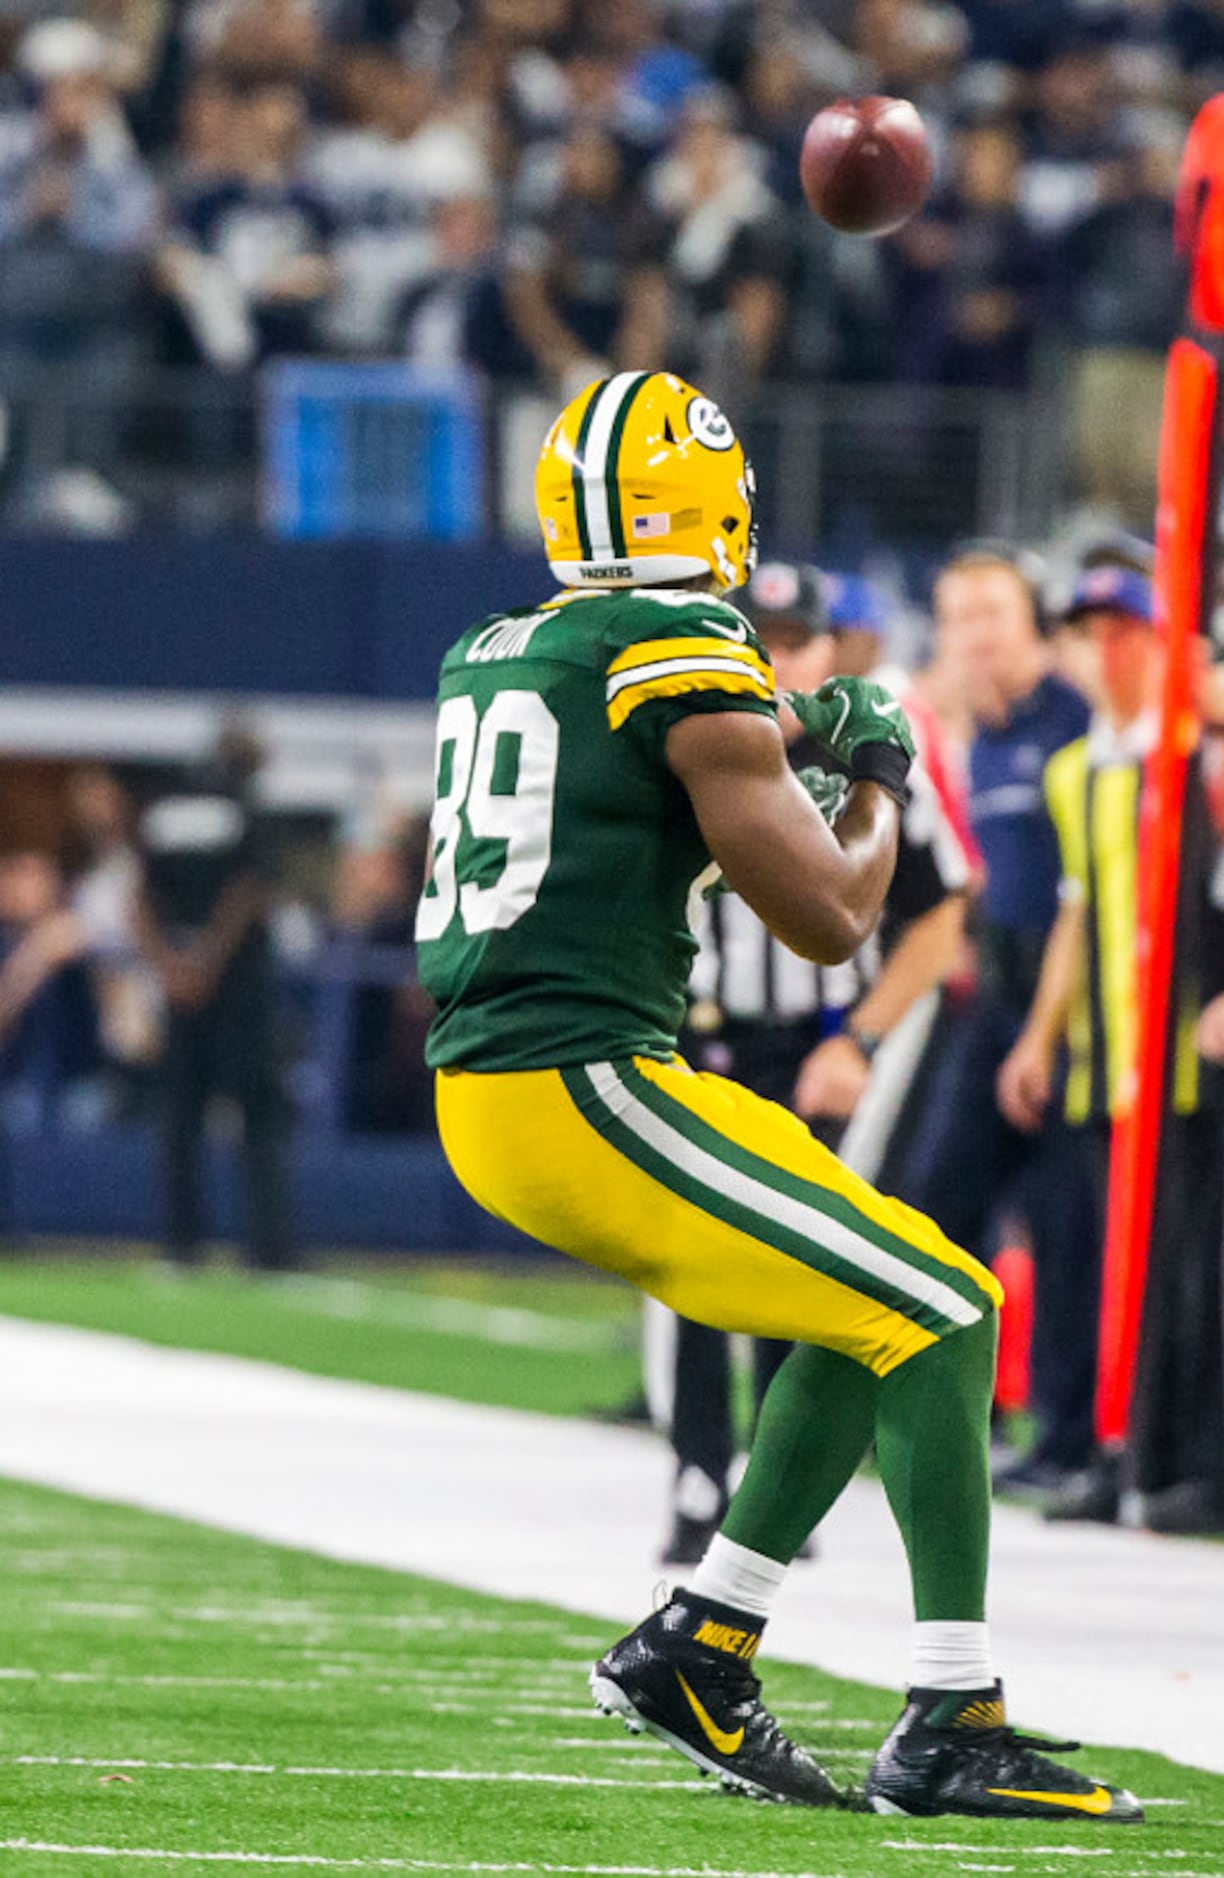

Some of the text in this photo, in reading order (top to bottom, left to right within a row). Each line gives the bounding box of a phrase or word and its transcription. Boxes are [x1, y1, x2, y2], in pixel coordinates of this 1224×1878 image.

[579, 565, 634, 579] PACKERS
[414, 689, 560, 943] 89
[692, 1619, 748, 1655] NIKE
